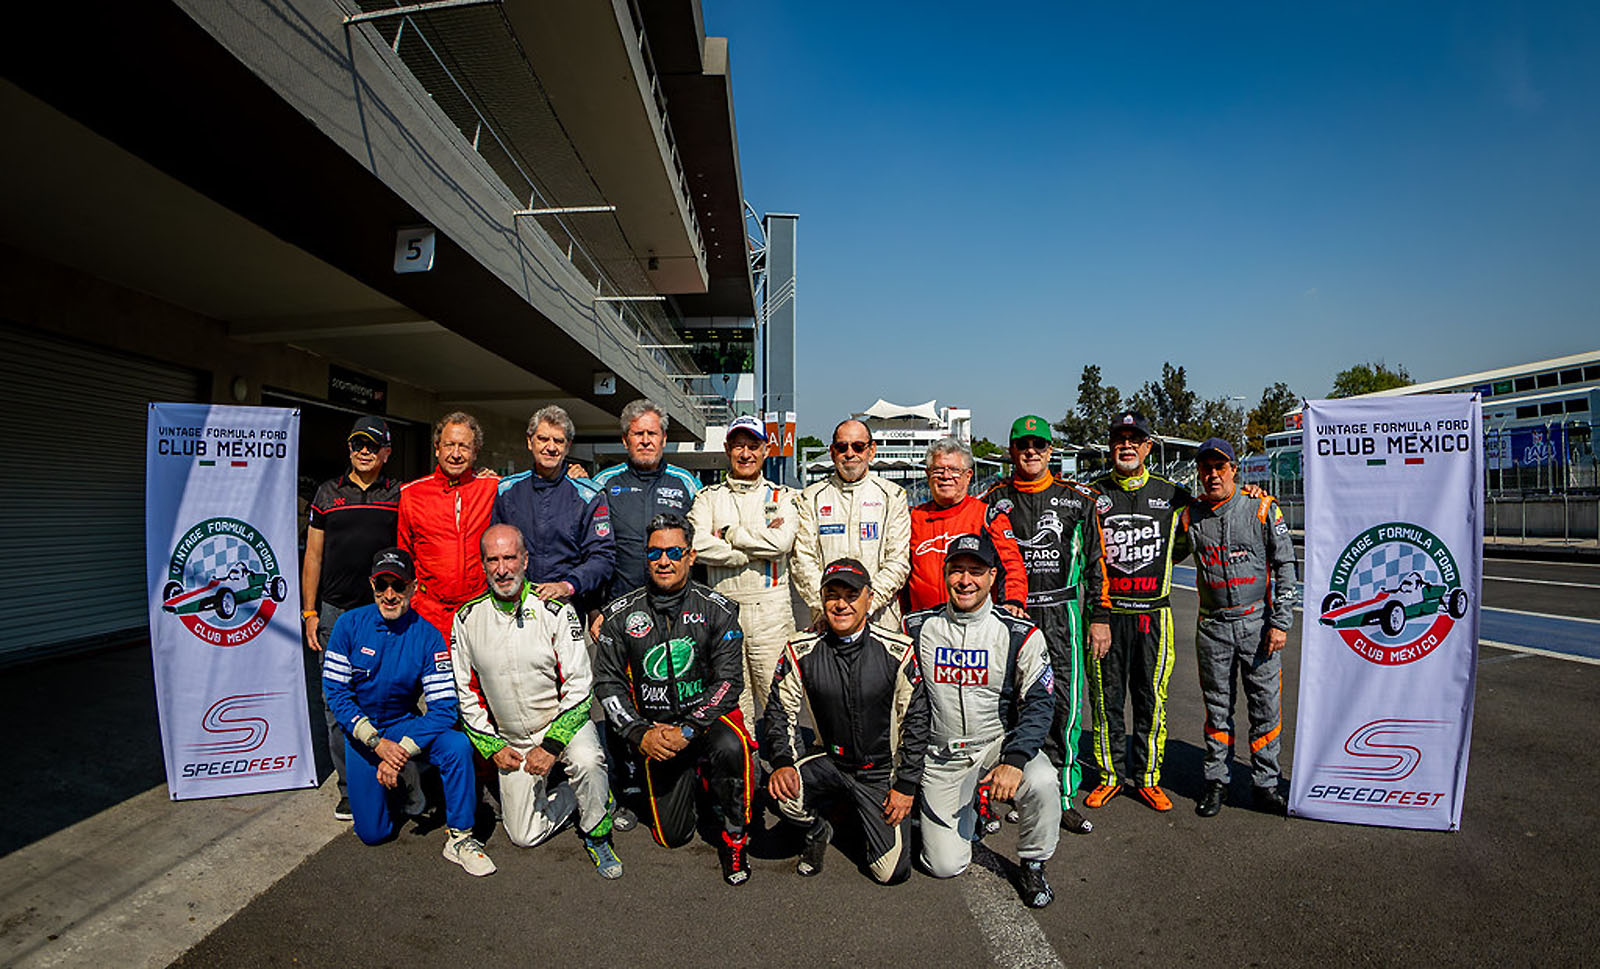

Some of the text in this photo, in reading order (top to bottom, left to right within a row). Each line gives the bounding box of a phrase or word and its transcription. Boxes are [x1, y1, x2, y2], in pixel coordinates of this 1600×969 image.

[405, 238, 423, 261] 5
[599, 376, 610, 390] 4
[158, 426, 288, 440] VINTAGE FORMULA FORD
[1025, 418, 1037, 431] C
[1316, 419, 1470, 435] VINTAGE FORMULA FORD
[158, 438, 287, 459] CLUB MÉXICO
[783, 432, 793, 447] A
[1316, 437, 1376, 456] CLUB
[1387, 432, 1470, 454] MÉXICO
[1102, 521, 1161, 546] Repel
[171, 521, 275, 575] VINTAGE FORMULA FORD
[1024, 549, 1061, 561] FARO
[1334, 526, 1456, 585] VINTAGE FORMULA FORD
[1109, 576, 1158, 590] MOTUL
[193, 623, 221, 643] CLUB
[937, 648, 986, 667] LIQUI
[1353, 638, 1384, 660] CLUB
[936, 666, 987, 684] MOLY
[181, 755, 298, 778] SPEEDFEST
[1307, 784, 1446, 807] SPEEDFEST
